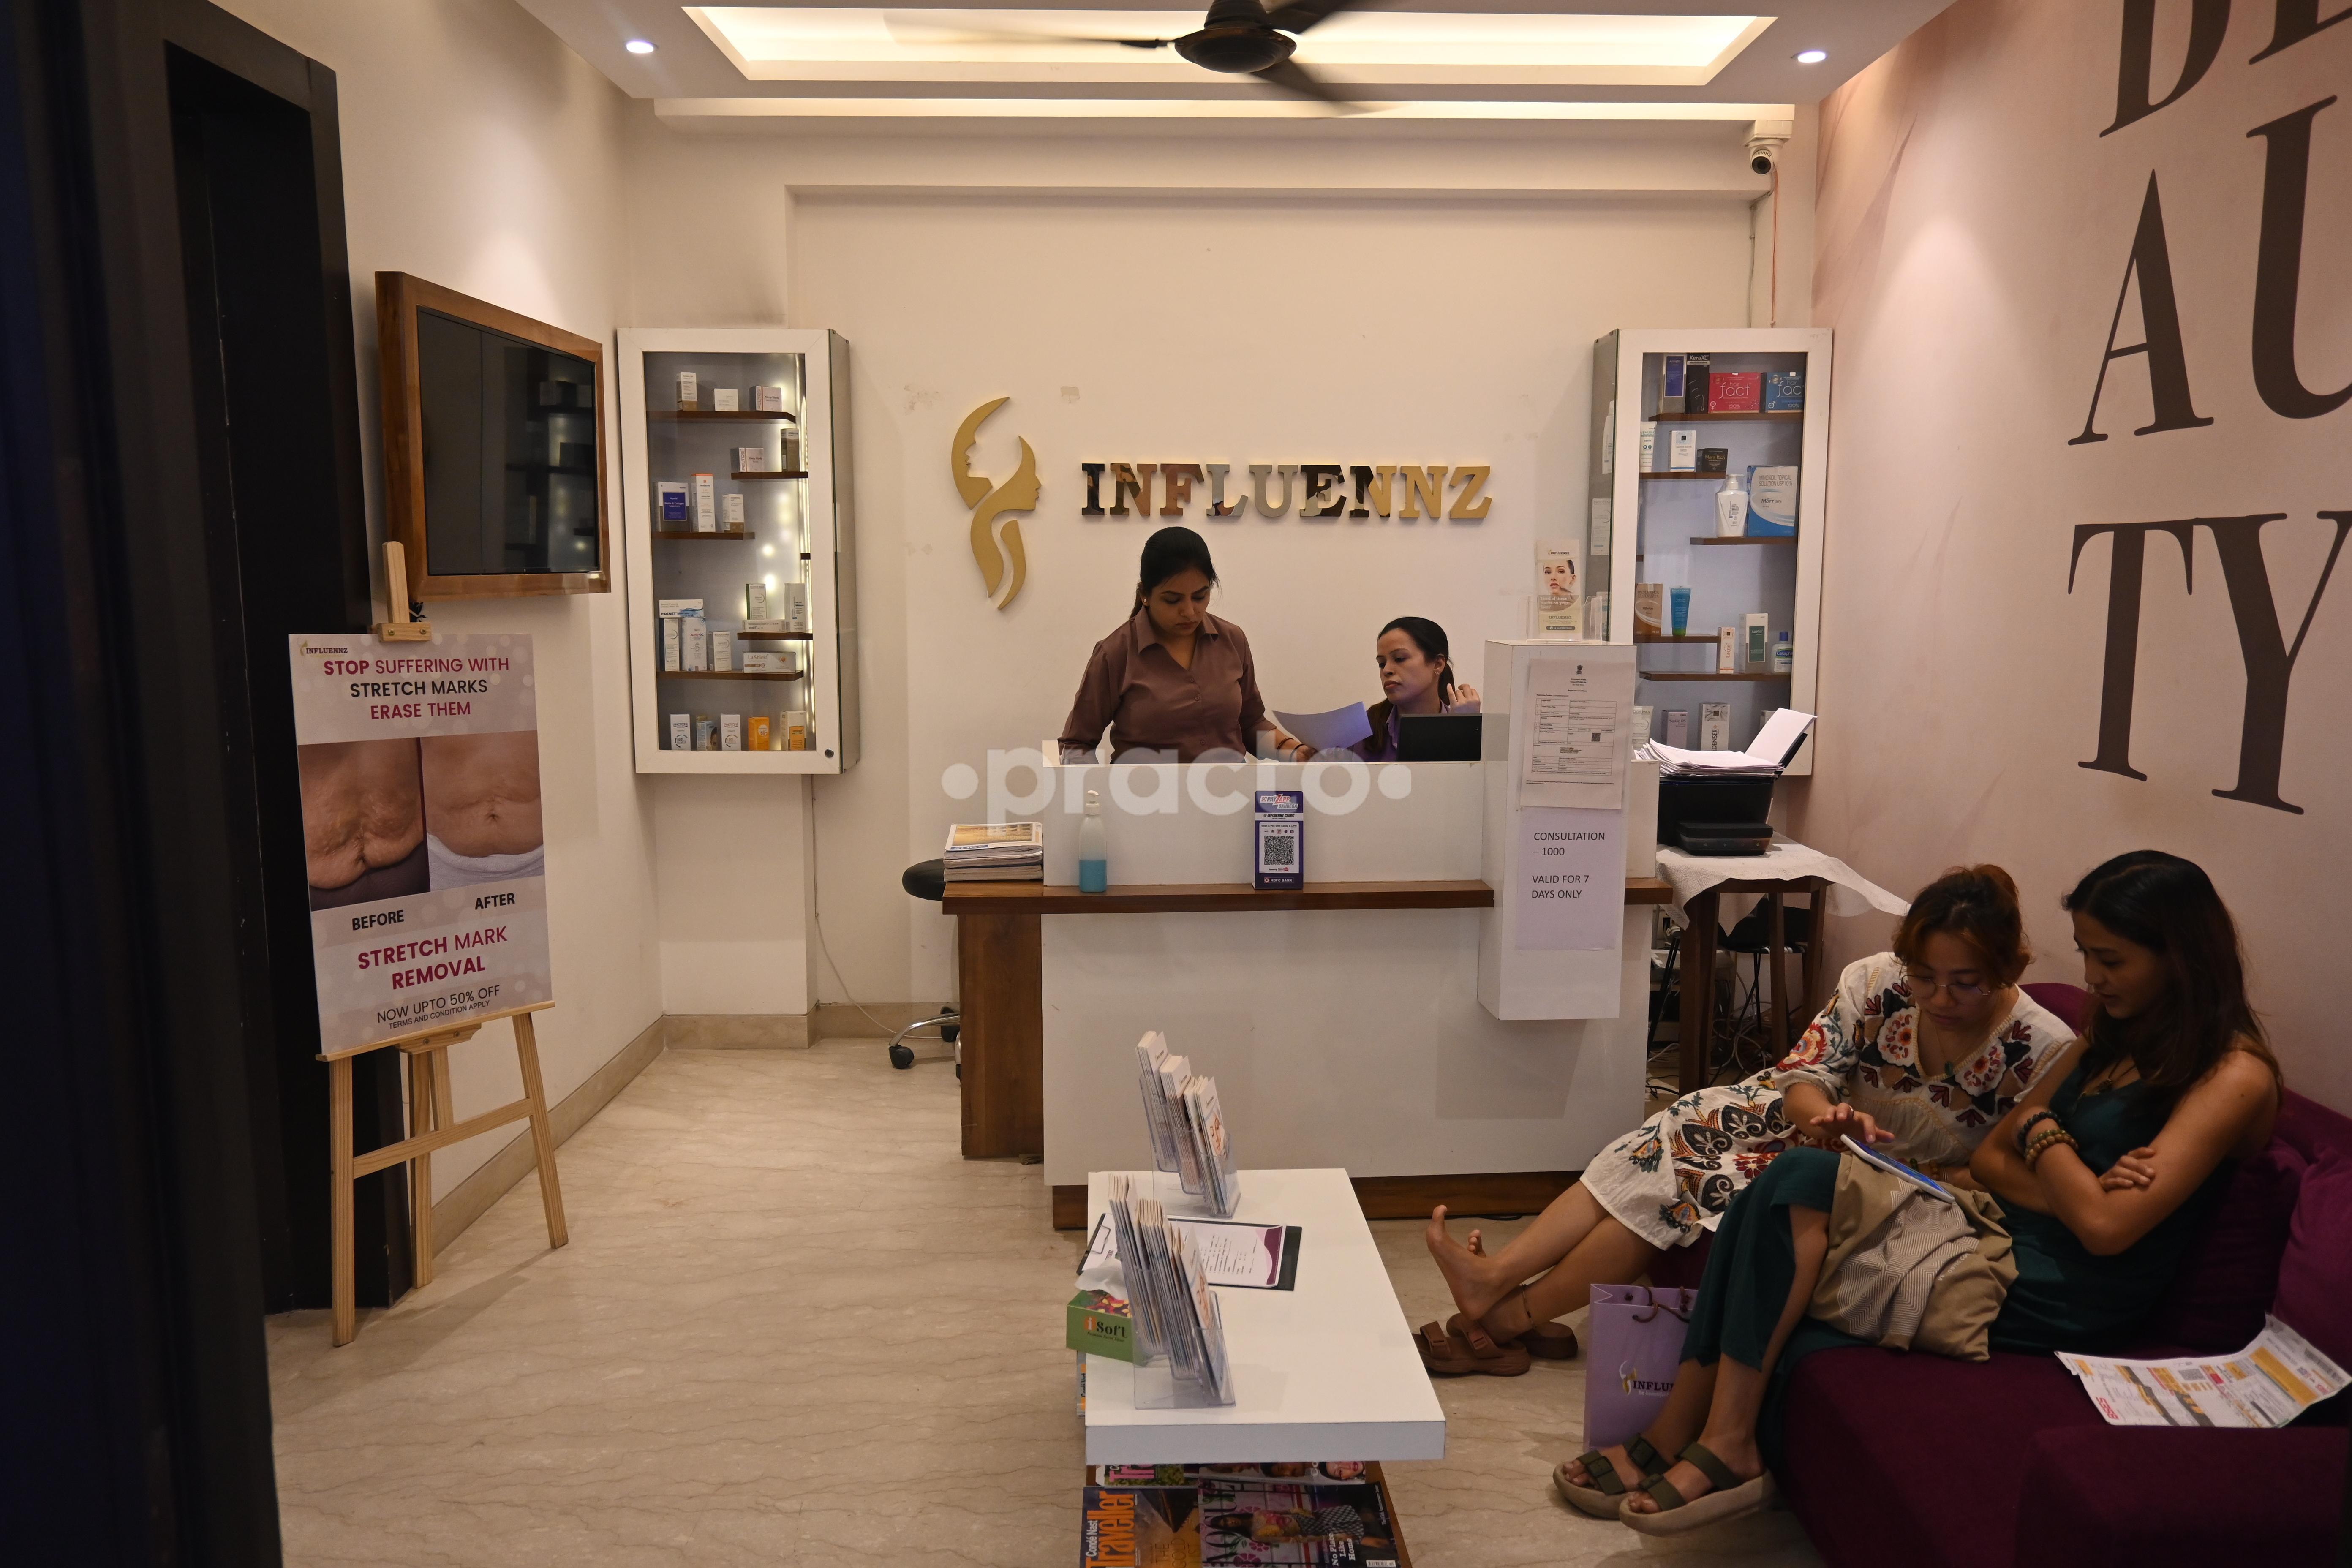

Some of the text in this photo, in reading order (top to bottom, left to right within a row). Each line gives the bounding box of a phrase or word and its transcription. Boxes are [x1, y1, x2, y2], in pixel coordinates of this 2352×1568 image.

[1719, 382, 1750, 399] fact
[1776, 381, 1805, 398] fac
[1081, 463, 1493, 519] INFLUENNZ
[324, 657, 509, 675] STOP SUFFERING WITH
[2068, 510, 2352, 815] TY
[350, 679, 487, 698] STRETCH MARKS
[370, 701, 471, 720] ERASE THEM
[1533, 832, 1605, 841] CONSULTATION
[1542, 847, 1565, 856] 1000
[1532, 875, 1589, 883] VALID FOR 7
[475, 893, 515, 910] AFTER
[1532, 890, 1582, 898] DAYS ONLY
[352, 909, 404, 931] BEFORE
[358, 926, 507, 969] STRETCH MARK
[392, 956, 485, 990] REMOVAL
[377, 985, 500, 1024] NOW UPTO 50% OFF
[389, 1000, 490, 1029] TERMS AND CONDITION APPLY
[1085, 1490, 1135, 1568] Traveller
[1086, 1520, 1098, 1557] Condé Nast
[1328, 1533, 1339, 1566] No Place
[1339, 1541, 1347, 1557] Like
[1347, 1538, 1356, 1561] Home
